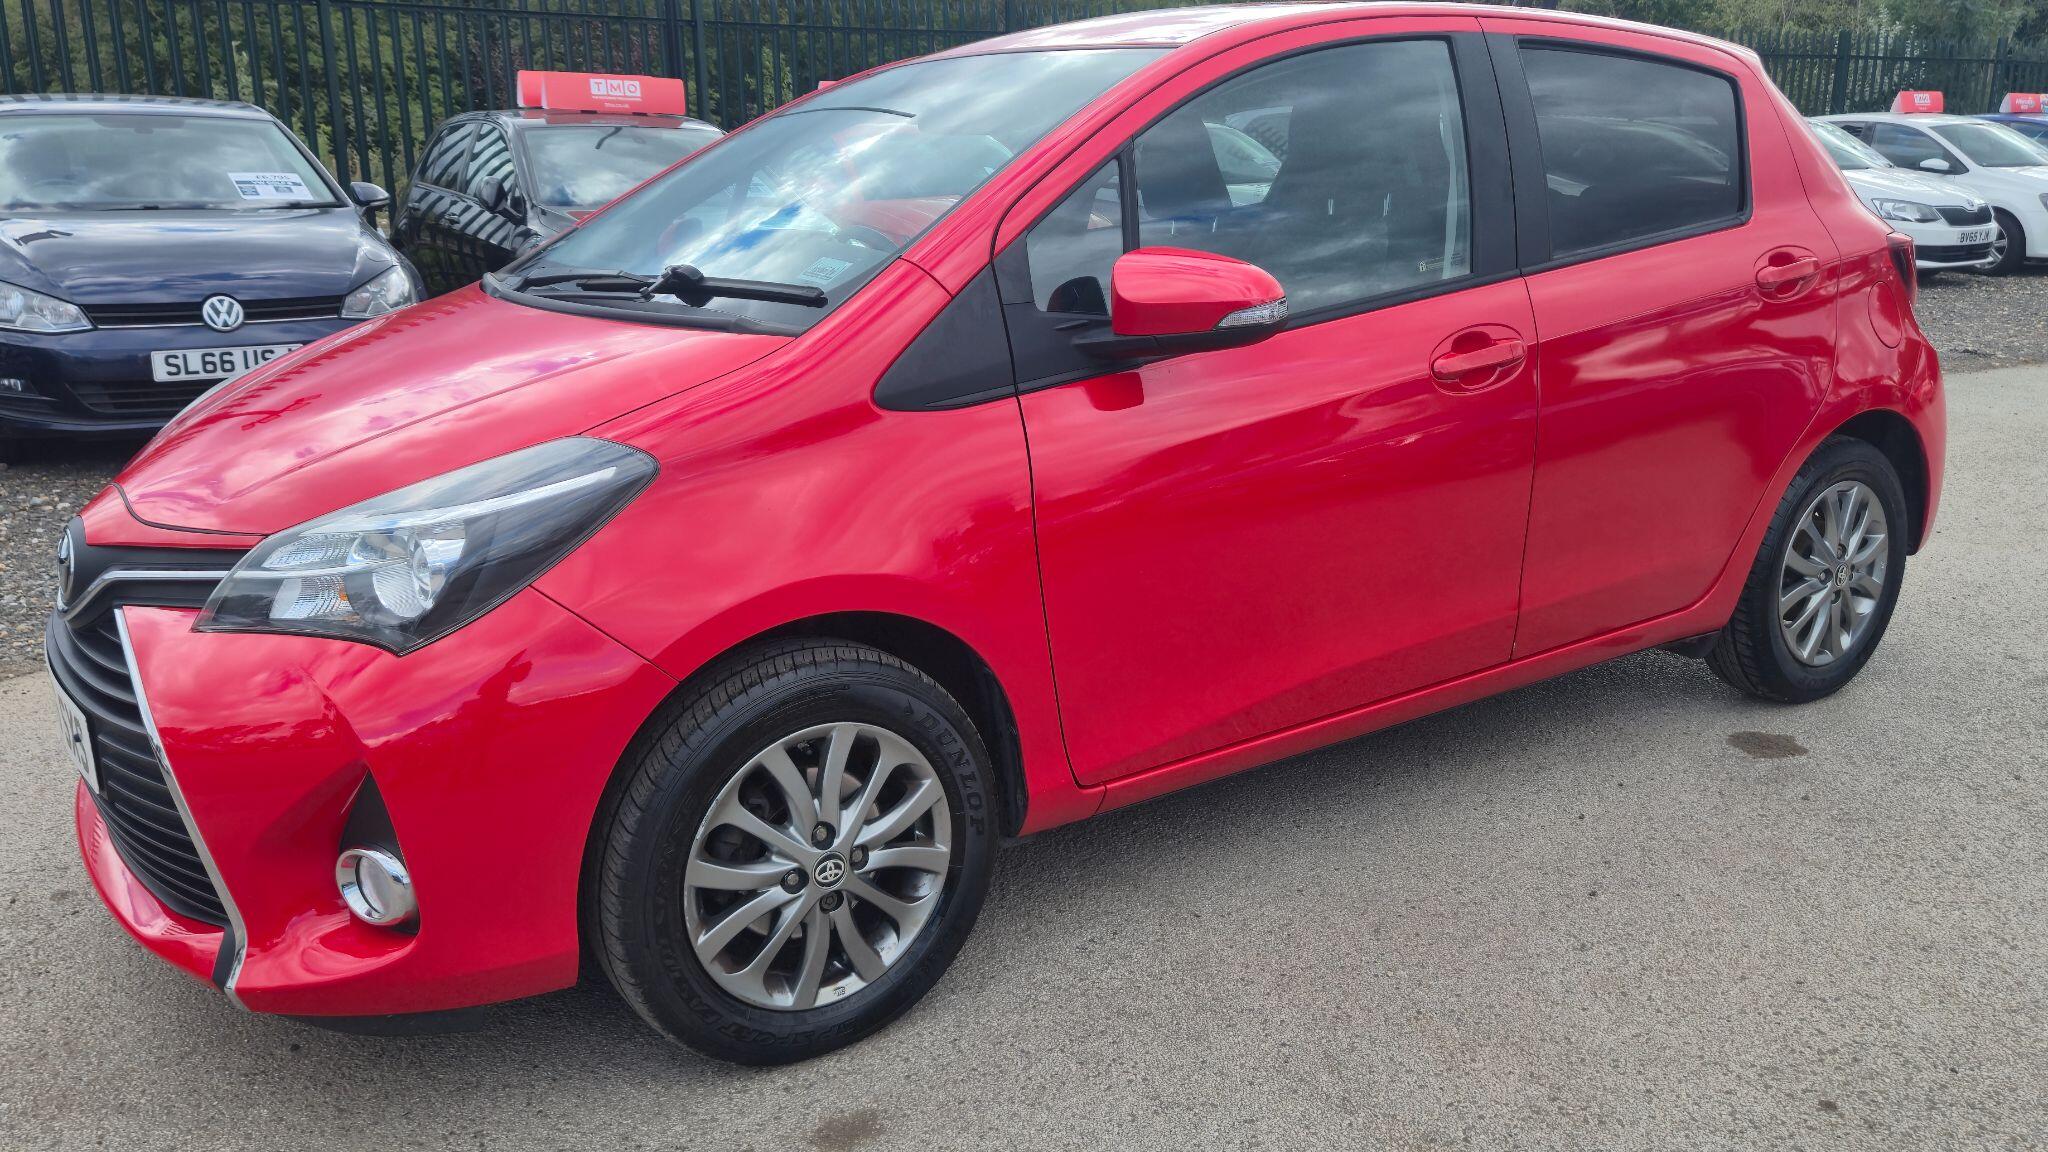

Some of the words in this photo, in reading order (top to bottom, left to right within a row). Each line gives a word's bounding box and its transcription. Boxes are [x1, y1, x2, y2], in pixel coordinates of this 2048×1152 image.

[592, 80, 640, 95] TMO
[1960, 231, 1978, 243] BV65
[164, 351, 235, 376] SL66
[919, 712, 986, 836] DUNLOP
